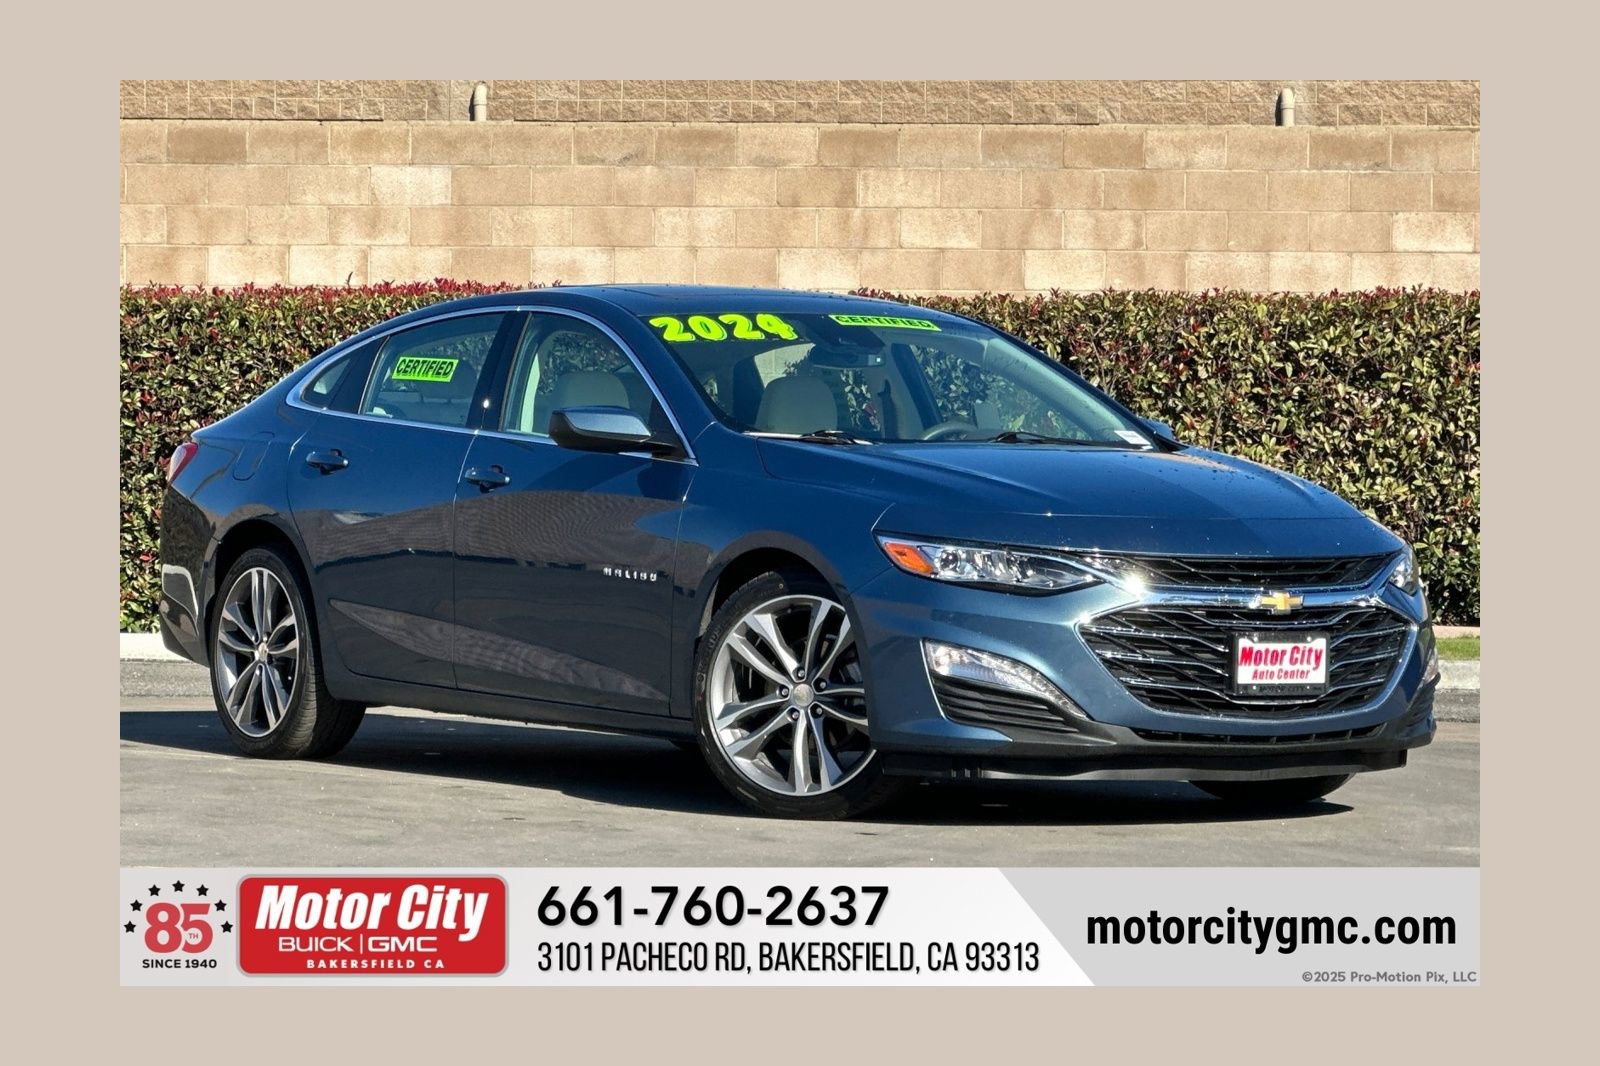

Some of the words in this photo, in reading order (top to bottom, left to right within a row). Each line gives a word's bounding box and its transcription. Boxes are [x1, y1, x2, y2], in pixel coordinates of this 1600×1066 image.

[649, 313, 799, 342] 2024
[834, 315, 935, 328] CERTIFIED
[397, 359, 454, 376] CERTIFIED
[603, 567, 657, 581] MALIBU
[1240, 646, 1287, 667] Motor
[1289, 645, 1323, 671] City
[1252, 669, 1275, 680] Auto
[1277, 668, 1310, 680] Center
